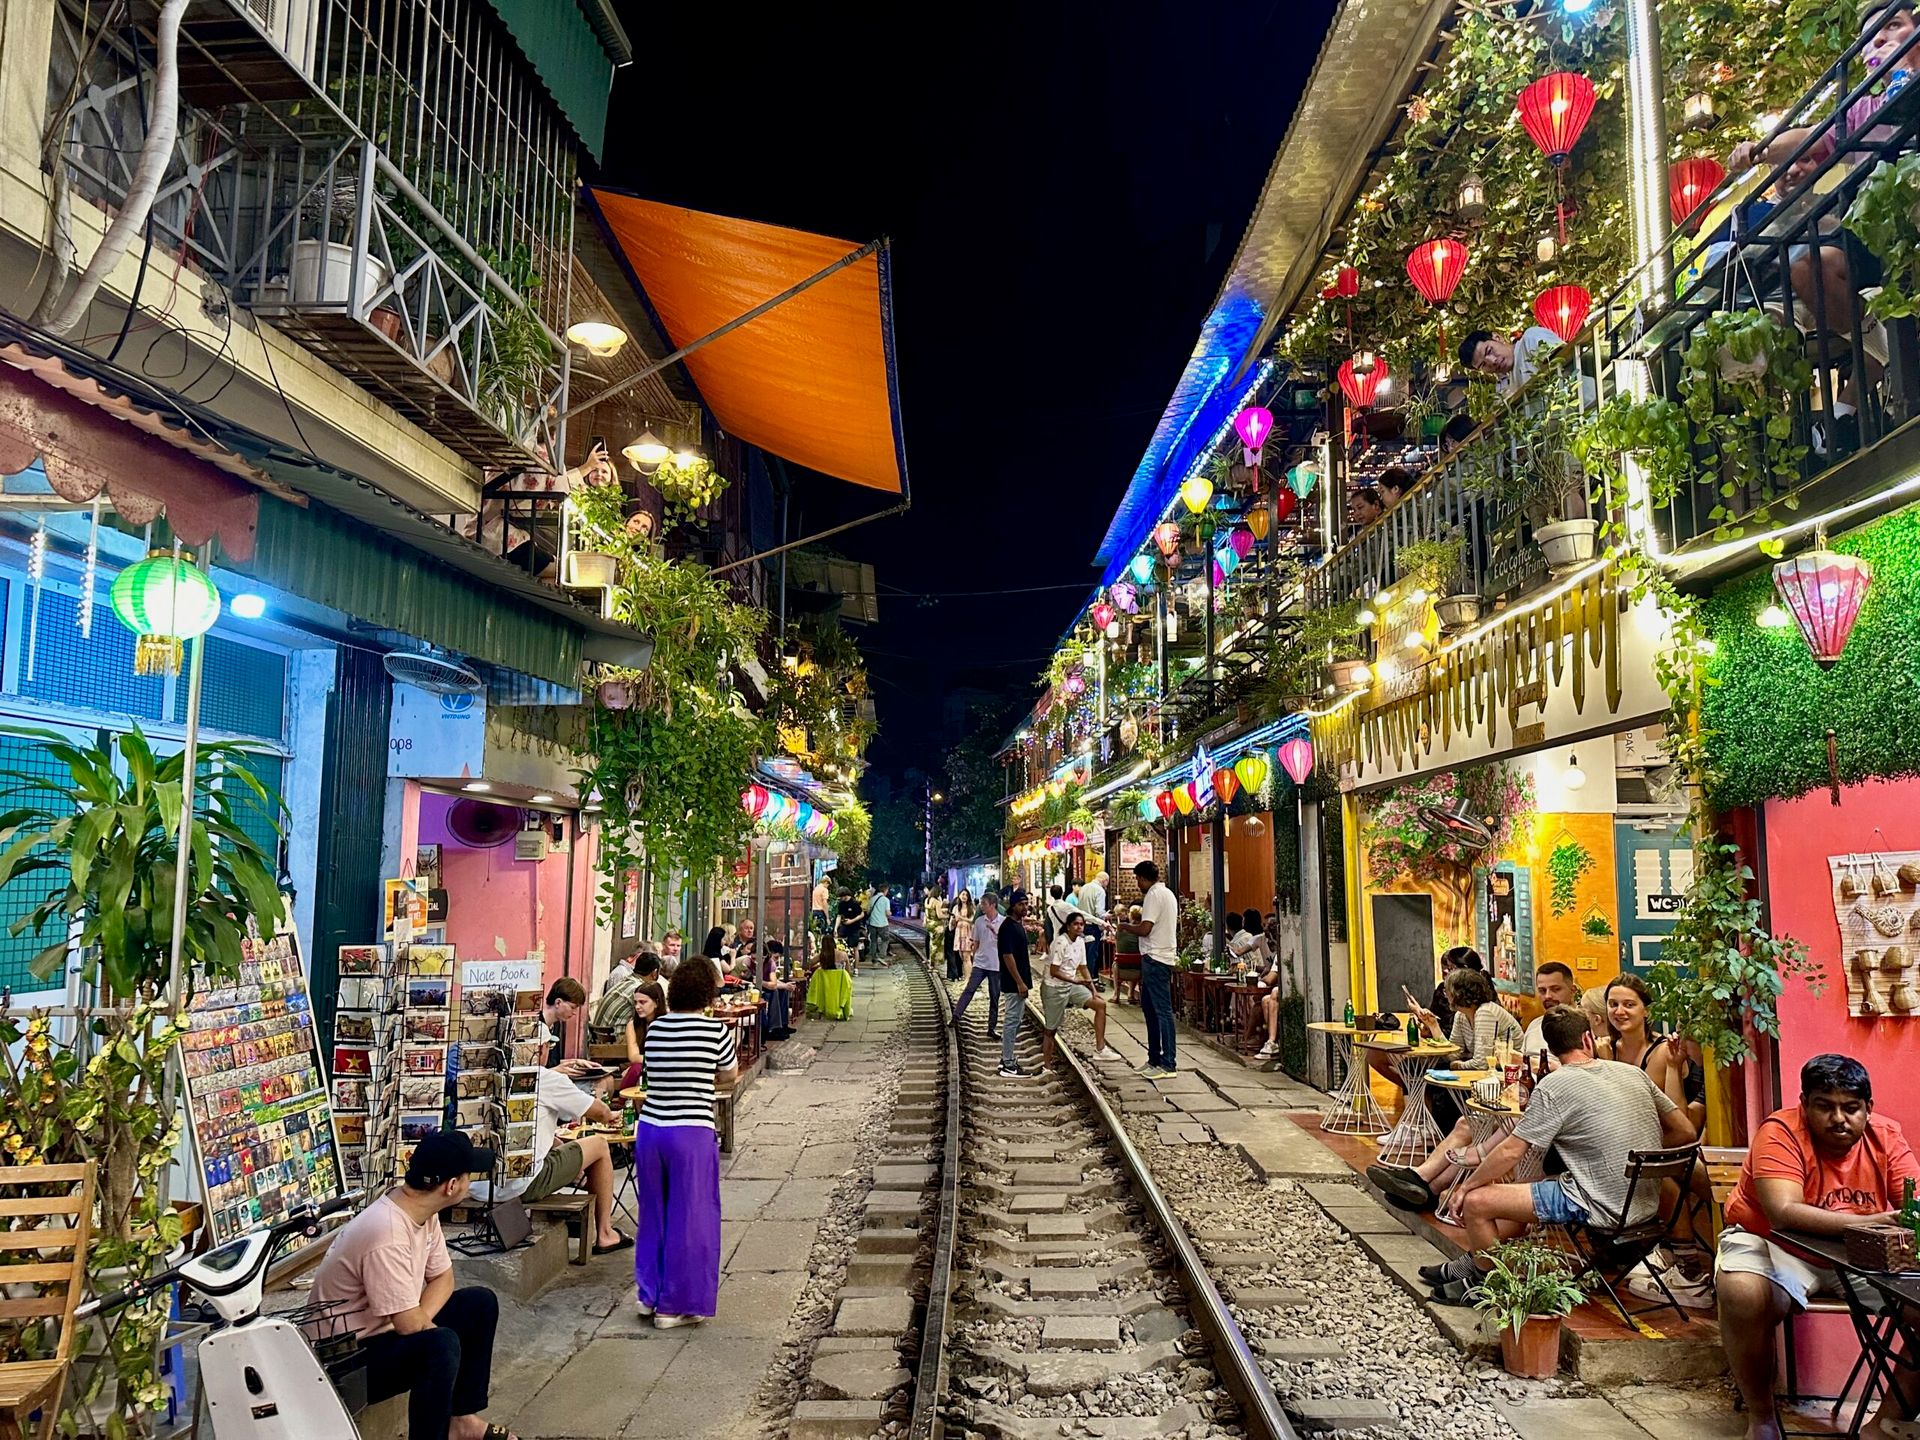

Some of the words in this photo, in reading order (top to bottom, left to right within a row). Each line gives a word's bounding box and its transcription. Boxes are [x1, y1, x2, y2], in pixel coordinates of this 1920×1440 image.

[390, 738, 413, 750] 008
[1086, 858, 1100, 871] 74
[469, 968, 495, 984] Note
[500, 965, 529, 981] Books
